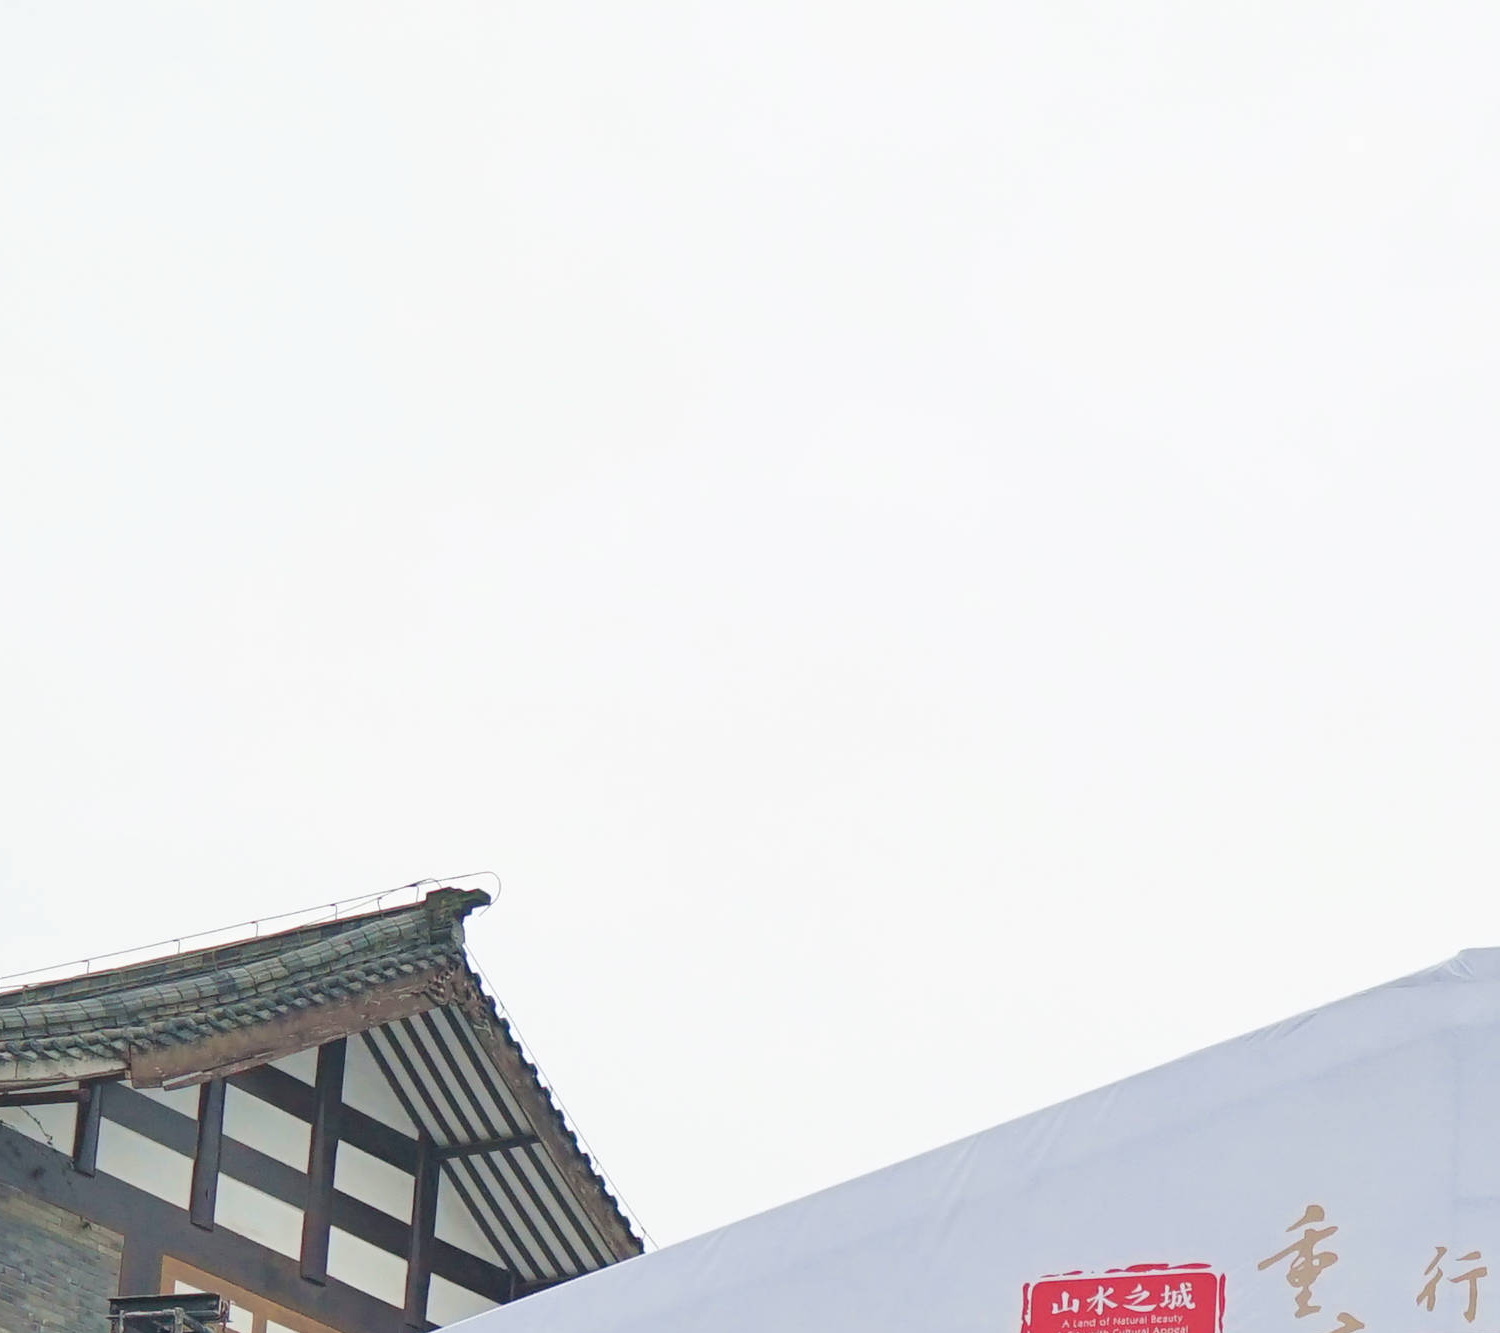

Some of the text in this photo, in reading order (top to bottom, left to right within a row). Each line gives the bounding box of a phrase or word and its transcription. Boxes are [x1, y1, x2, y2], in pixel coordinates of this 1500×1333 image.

[1050, 1281, 1197, 1316] 山水之城
[1061, 1314, 1184, 1329] A Land of Natural Beauty
